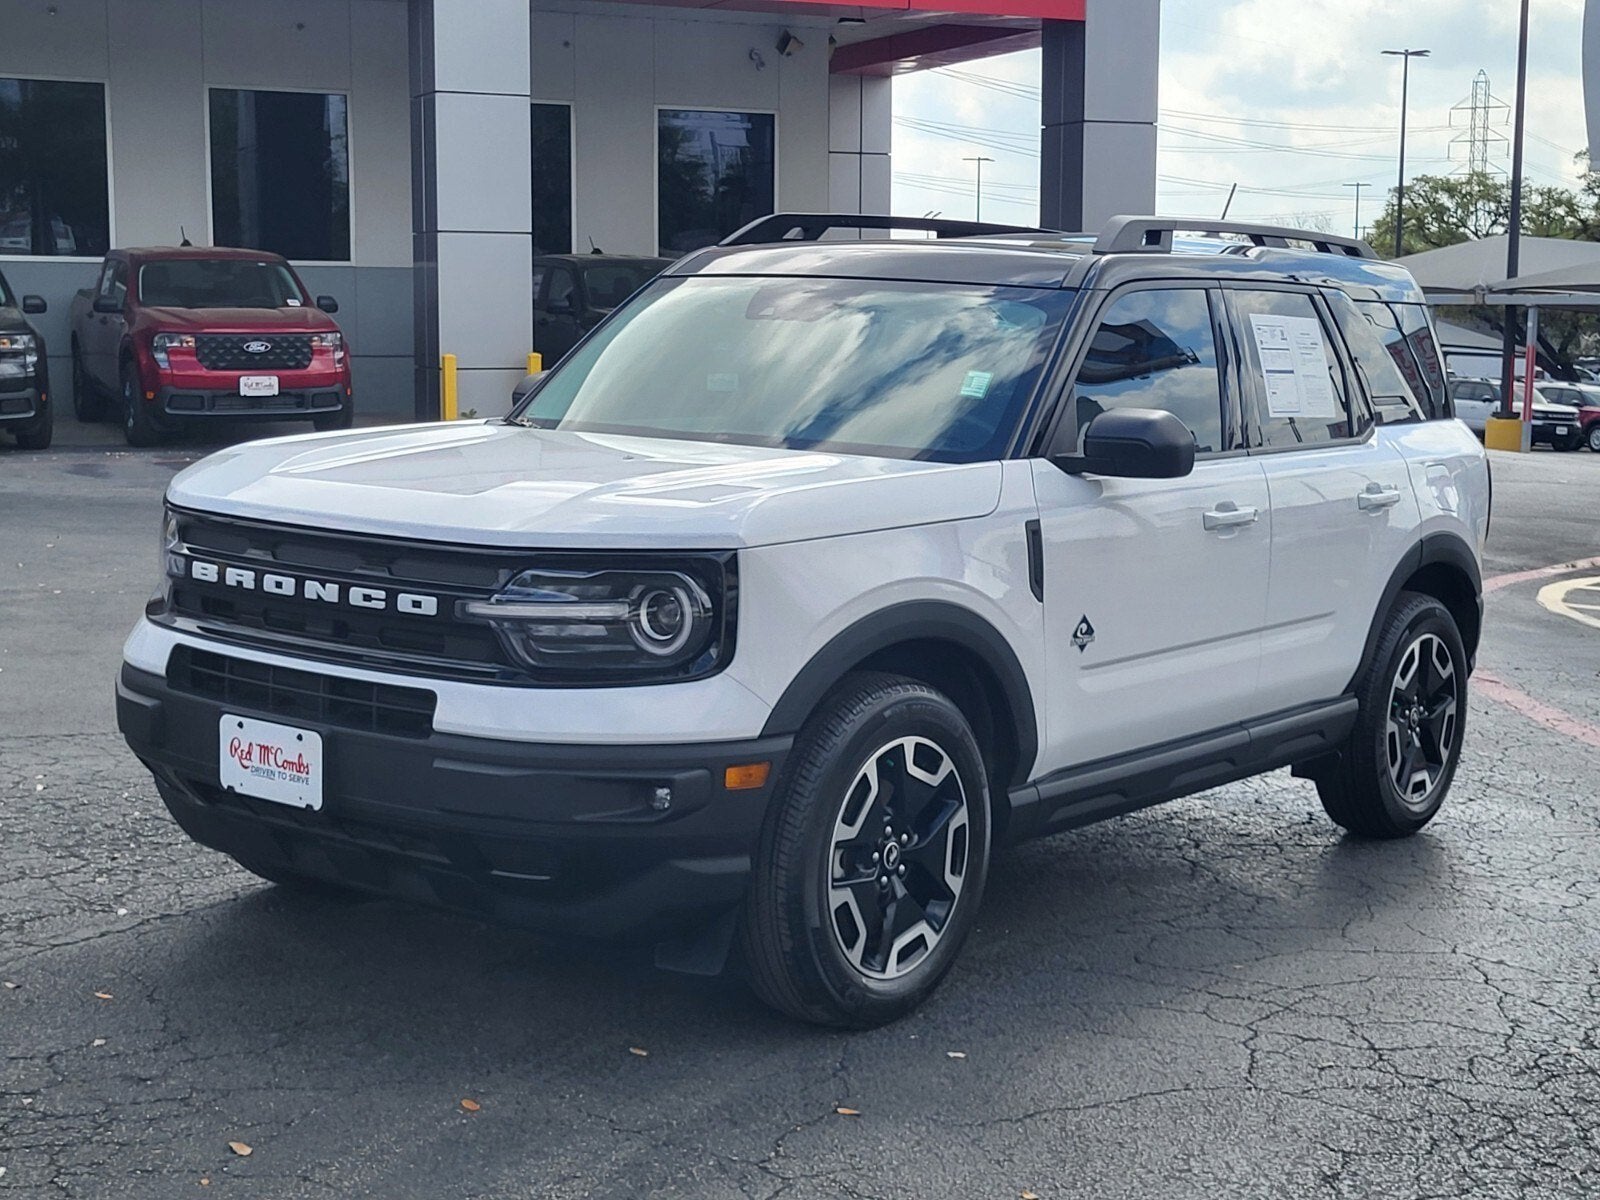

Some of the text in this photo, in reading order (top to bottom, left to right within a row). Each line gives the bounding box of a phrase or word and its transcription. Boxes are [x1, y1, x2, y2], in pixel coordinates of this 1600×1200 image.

[192, 560, 438, 616] BRONCO
[230, 737, 311, 775] Red McCombs
[250, 765, 310, 785] DRIVEN TO SERVE
